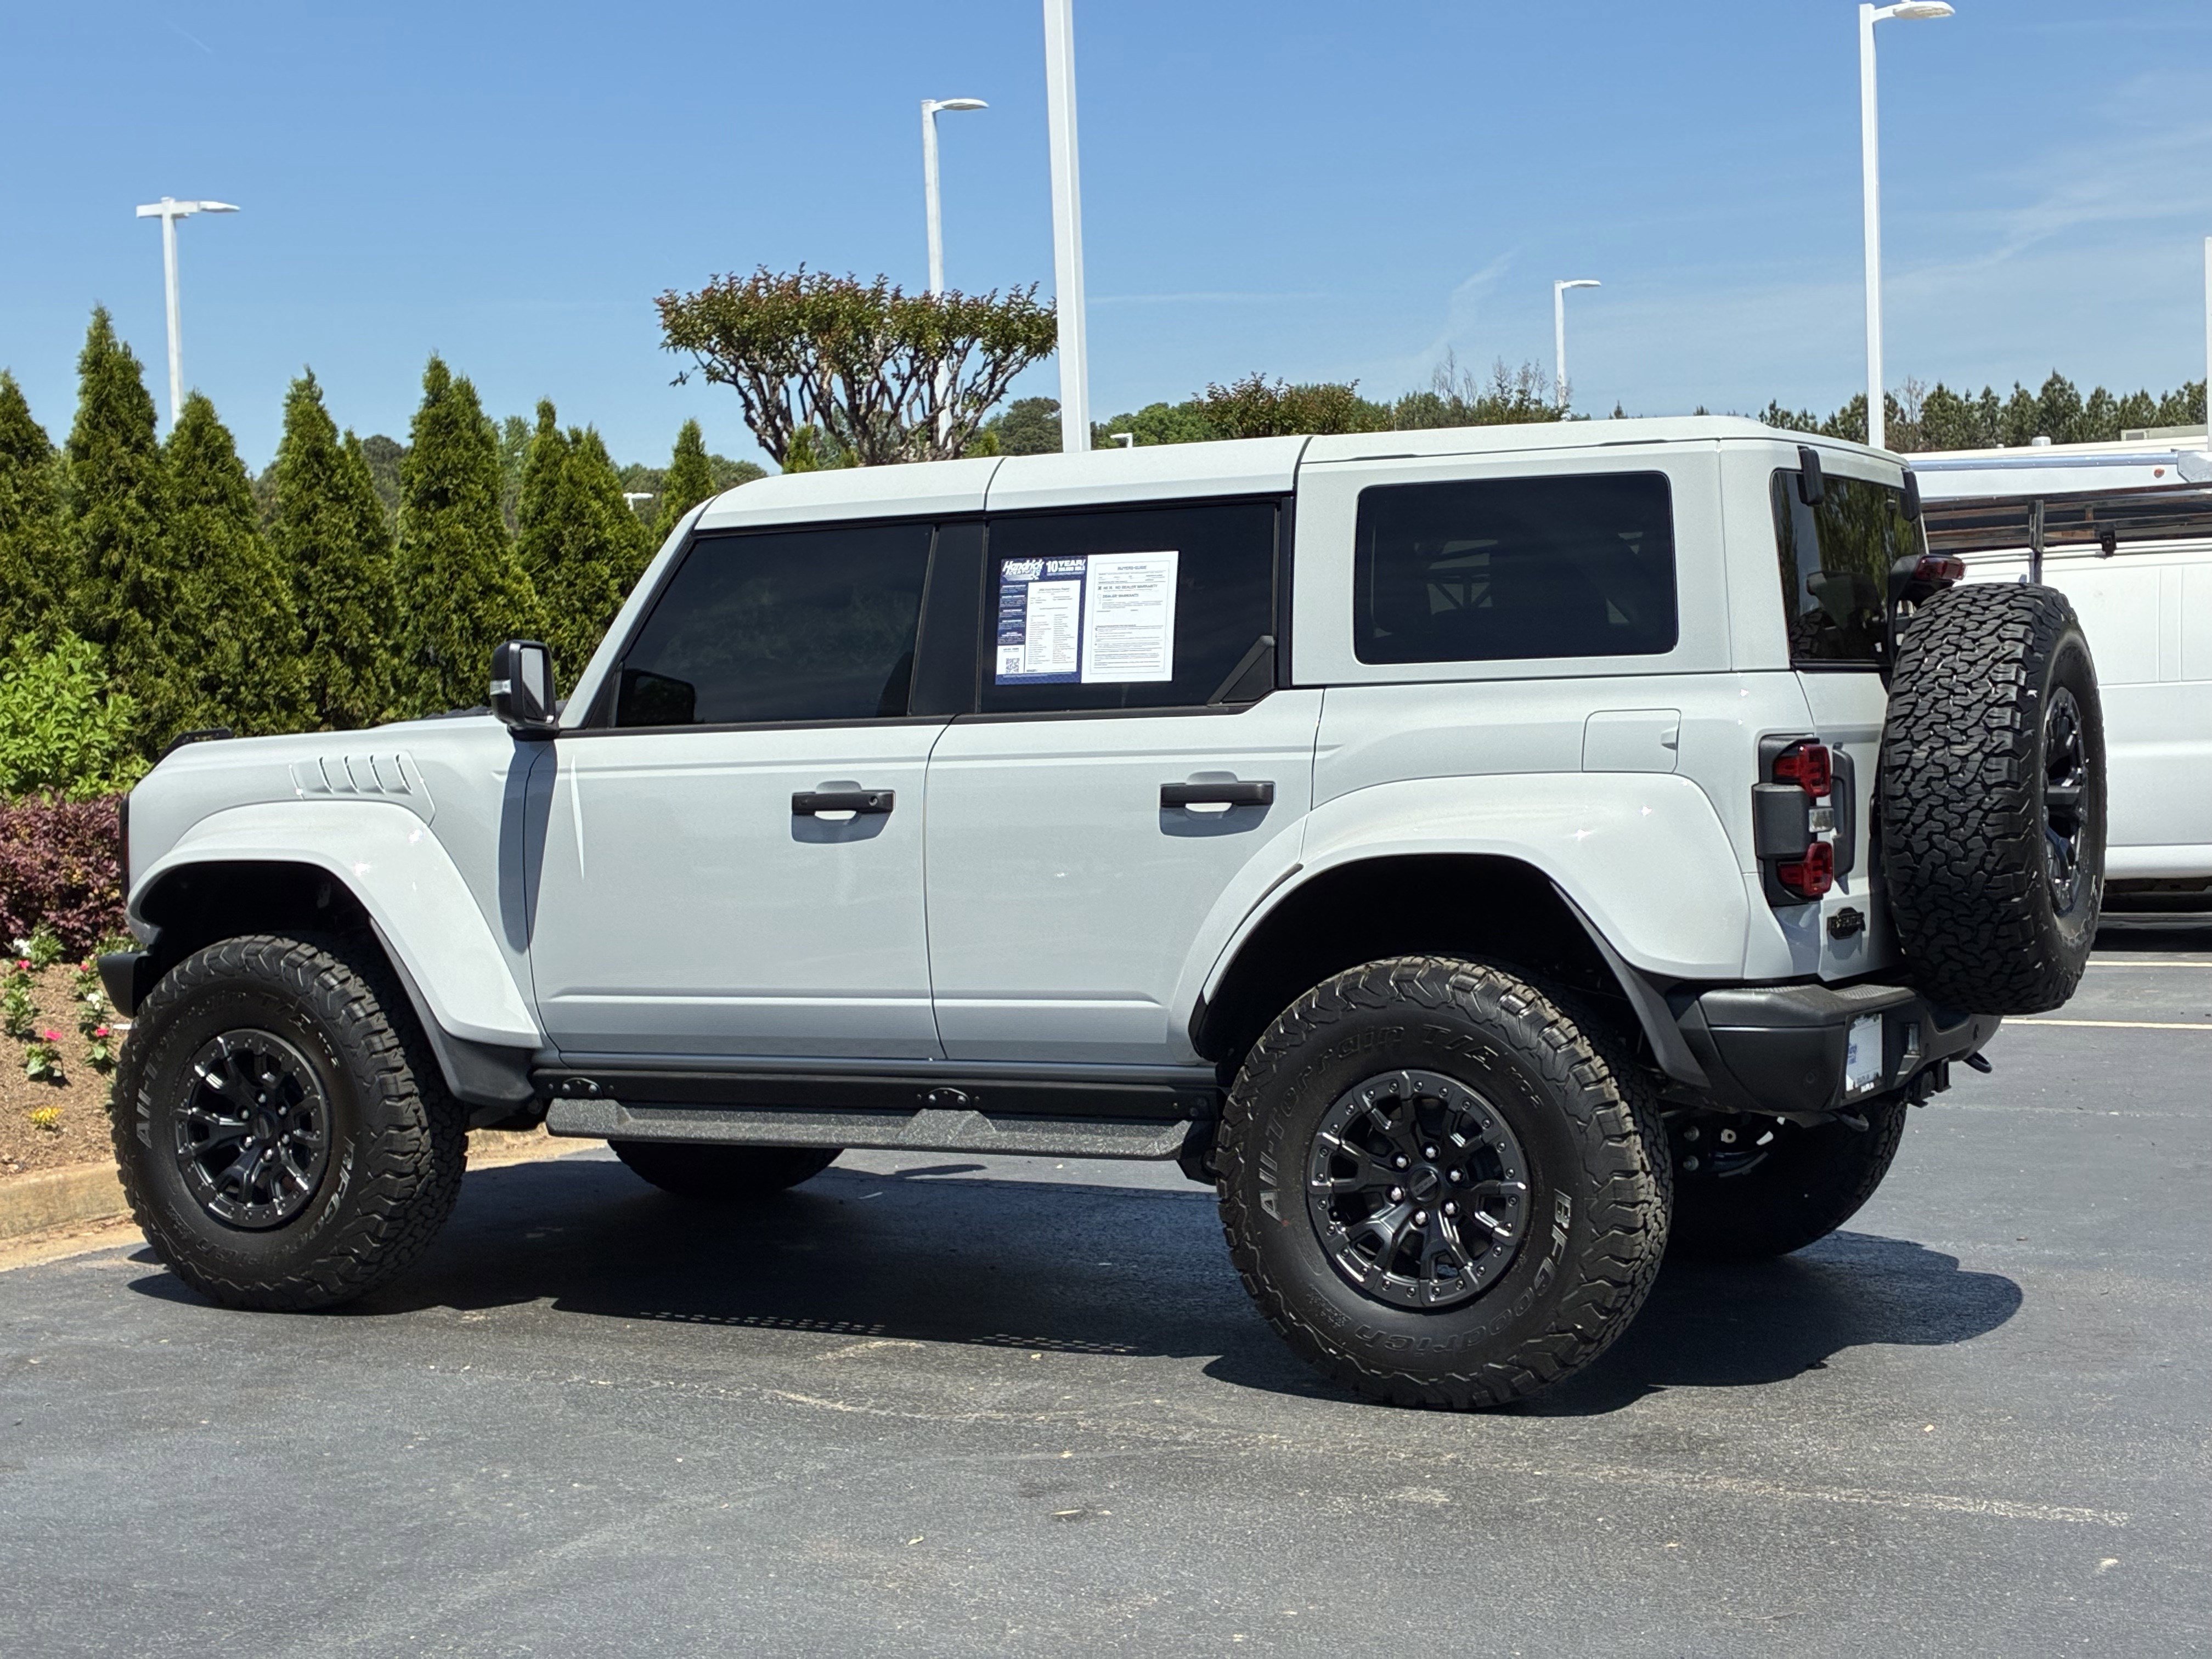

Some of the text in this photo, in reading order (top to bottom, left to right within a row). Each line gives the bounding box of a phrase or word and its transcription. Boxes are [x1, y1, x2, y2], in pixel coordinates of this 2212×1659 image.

[1046, 560, 1058, 573] 10
[1259, 1026, 1404, 1222] All-Terrain
[1422, 1024, 1499, 1070] T/A
[1355, 1188, 1572, 1357] BFGoodrich
